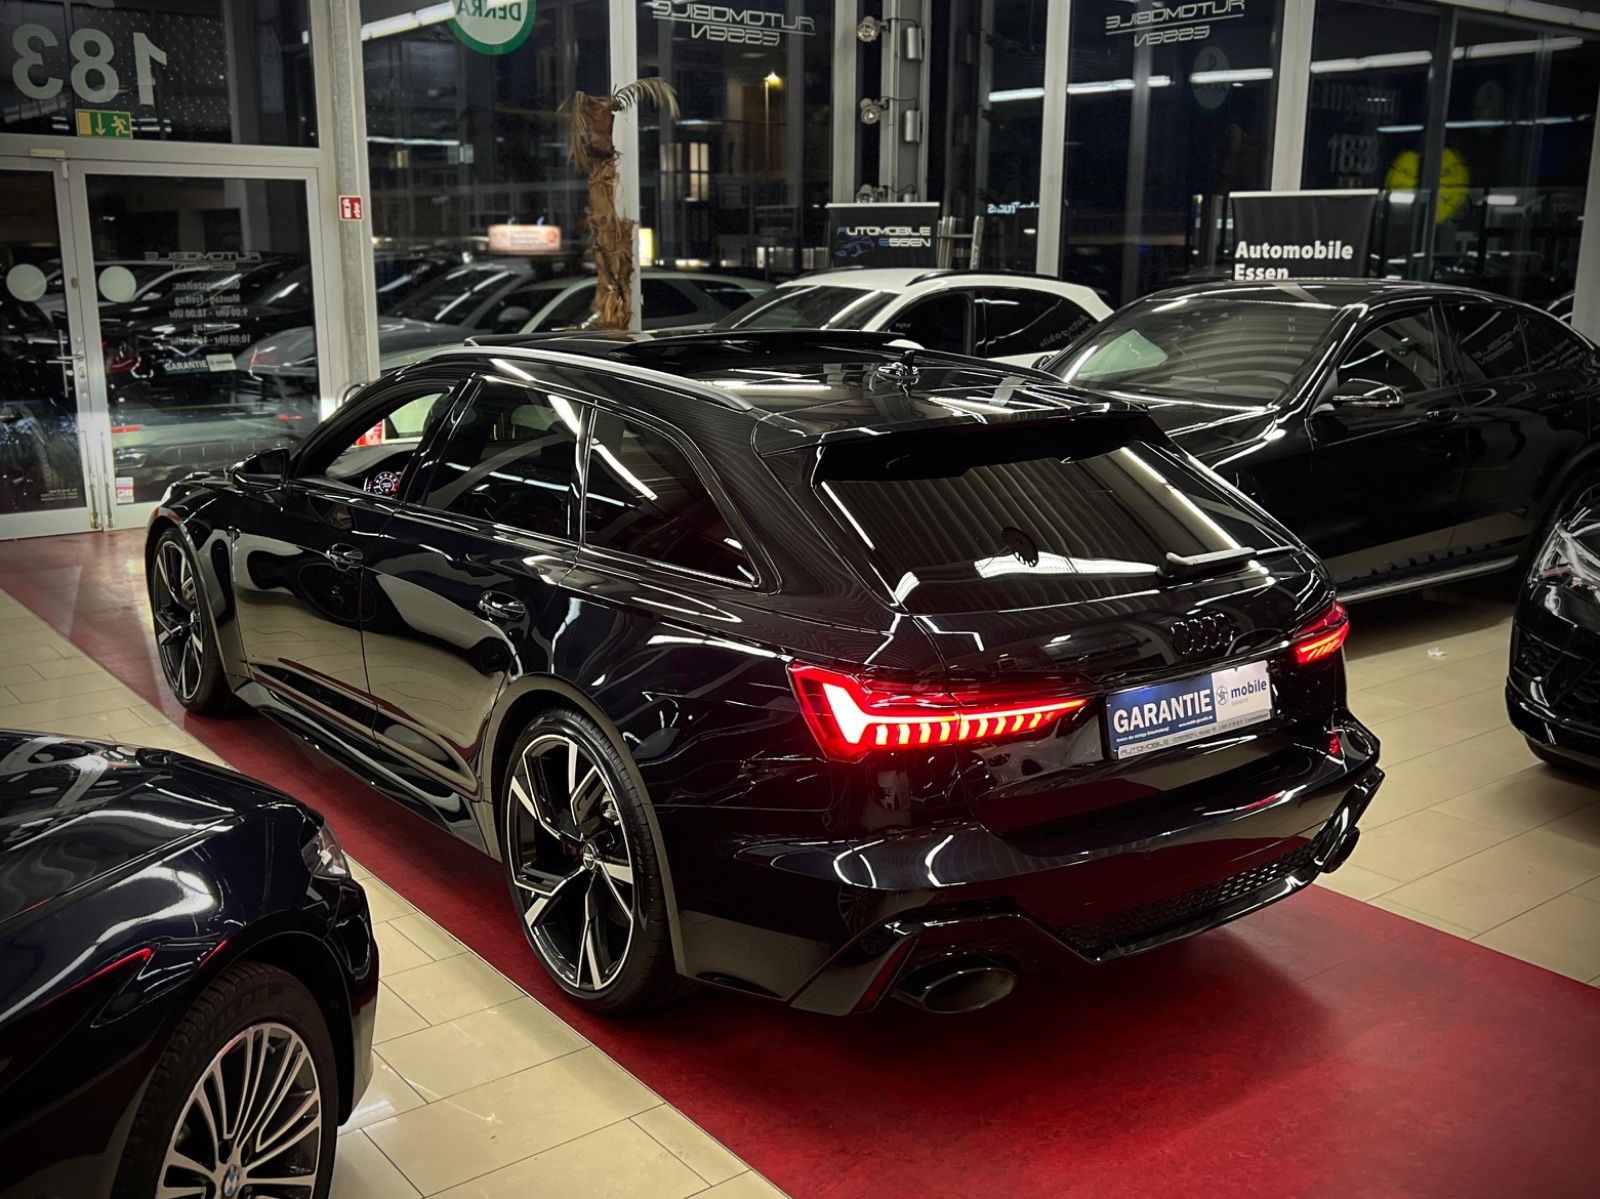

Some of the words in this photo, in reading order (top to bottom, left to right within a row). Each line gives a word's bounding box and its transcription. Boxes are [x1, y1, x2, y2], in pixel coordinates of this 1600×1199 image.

[836, 226, 931, 236] AUTOMOBILE
[878, 238, 931, 247] ESSEN
[1234, 240, 1353, 259] Automobile
[1234, 263, 1289, 279] Essen
[164, 359, 208, 371] GARANTIE
[1231, 678, 1267, 698] mobile
[1113, 689, 1213, 734] GARANTIE
